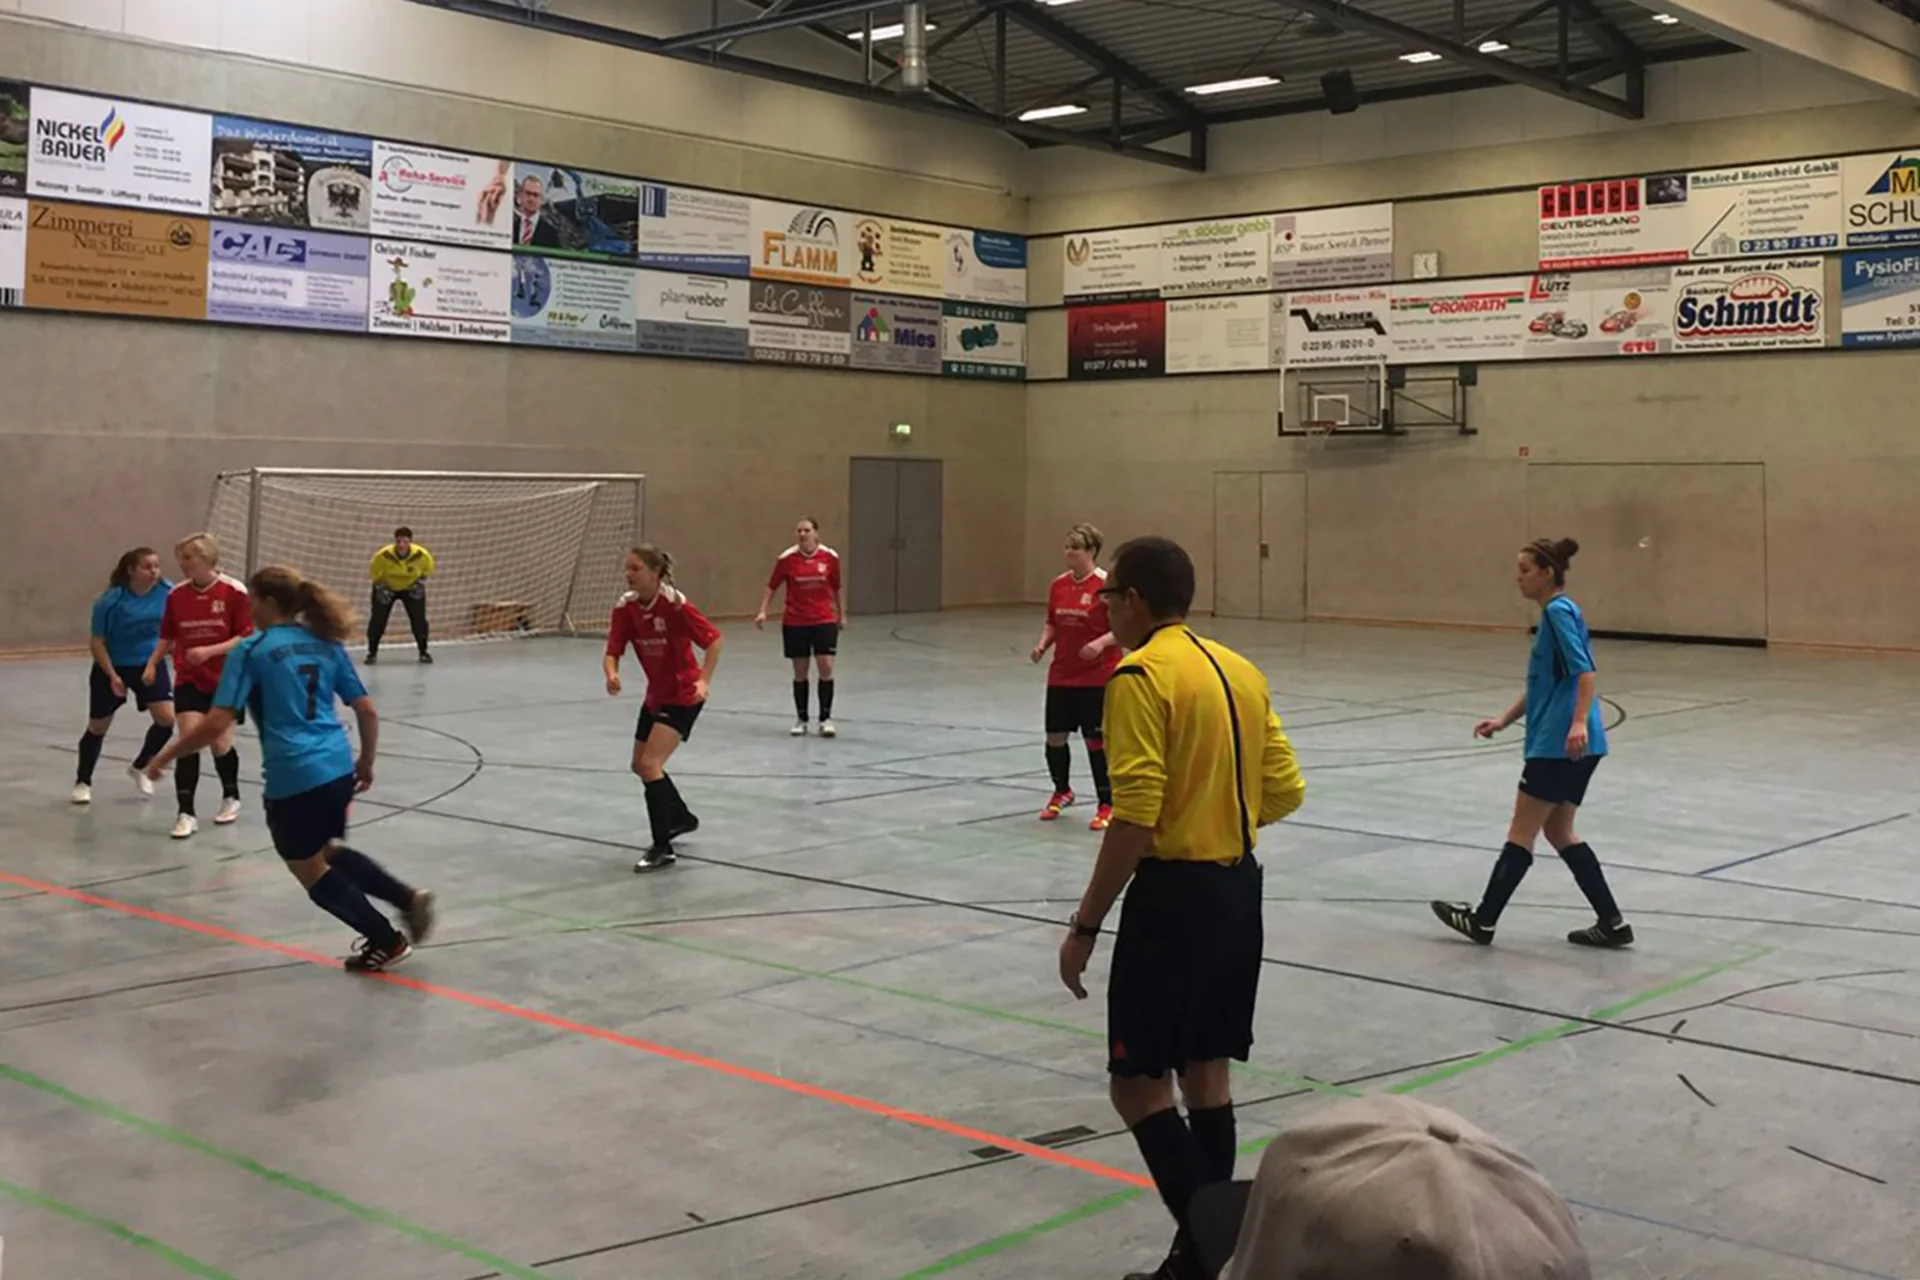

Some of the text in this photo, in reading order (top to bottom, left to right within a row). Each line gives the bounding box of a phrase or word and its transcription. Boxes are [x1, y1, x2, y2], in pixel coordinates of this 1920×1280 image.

[36, 118, 103, 145] NICKEL
[41, 139, 106, 164] BAUER
[1803, 160, 1839, 175] GmbH
[1891, 170, 1915, 194] M
[31, 204, 134, 239] Zimmerei
[1540, 214, 1640, 231] DEUTSCHLAND
[763, 229, 839, 274] FLAMM
[1697, 265, 1720, 276] dem
[1764, 260, 1783, 271] der
[1786, 258, 1821, 270] Natur
[1429, 299, 1506, 314] CRONRATH
[1677, 291, 1818, 328] Schmidt
[372, 316, 412, 330] Zimmerei
[894, 328, 937, 348] Mies
[298, 664, 321, 721] 7
